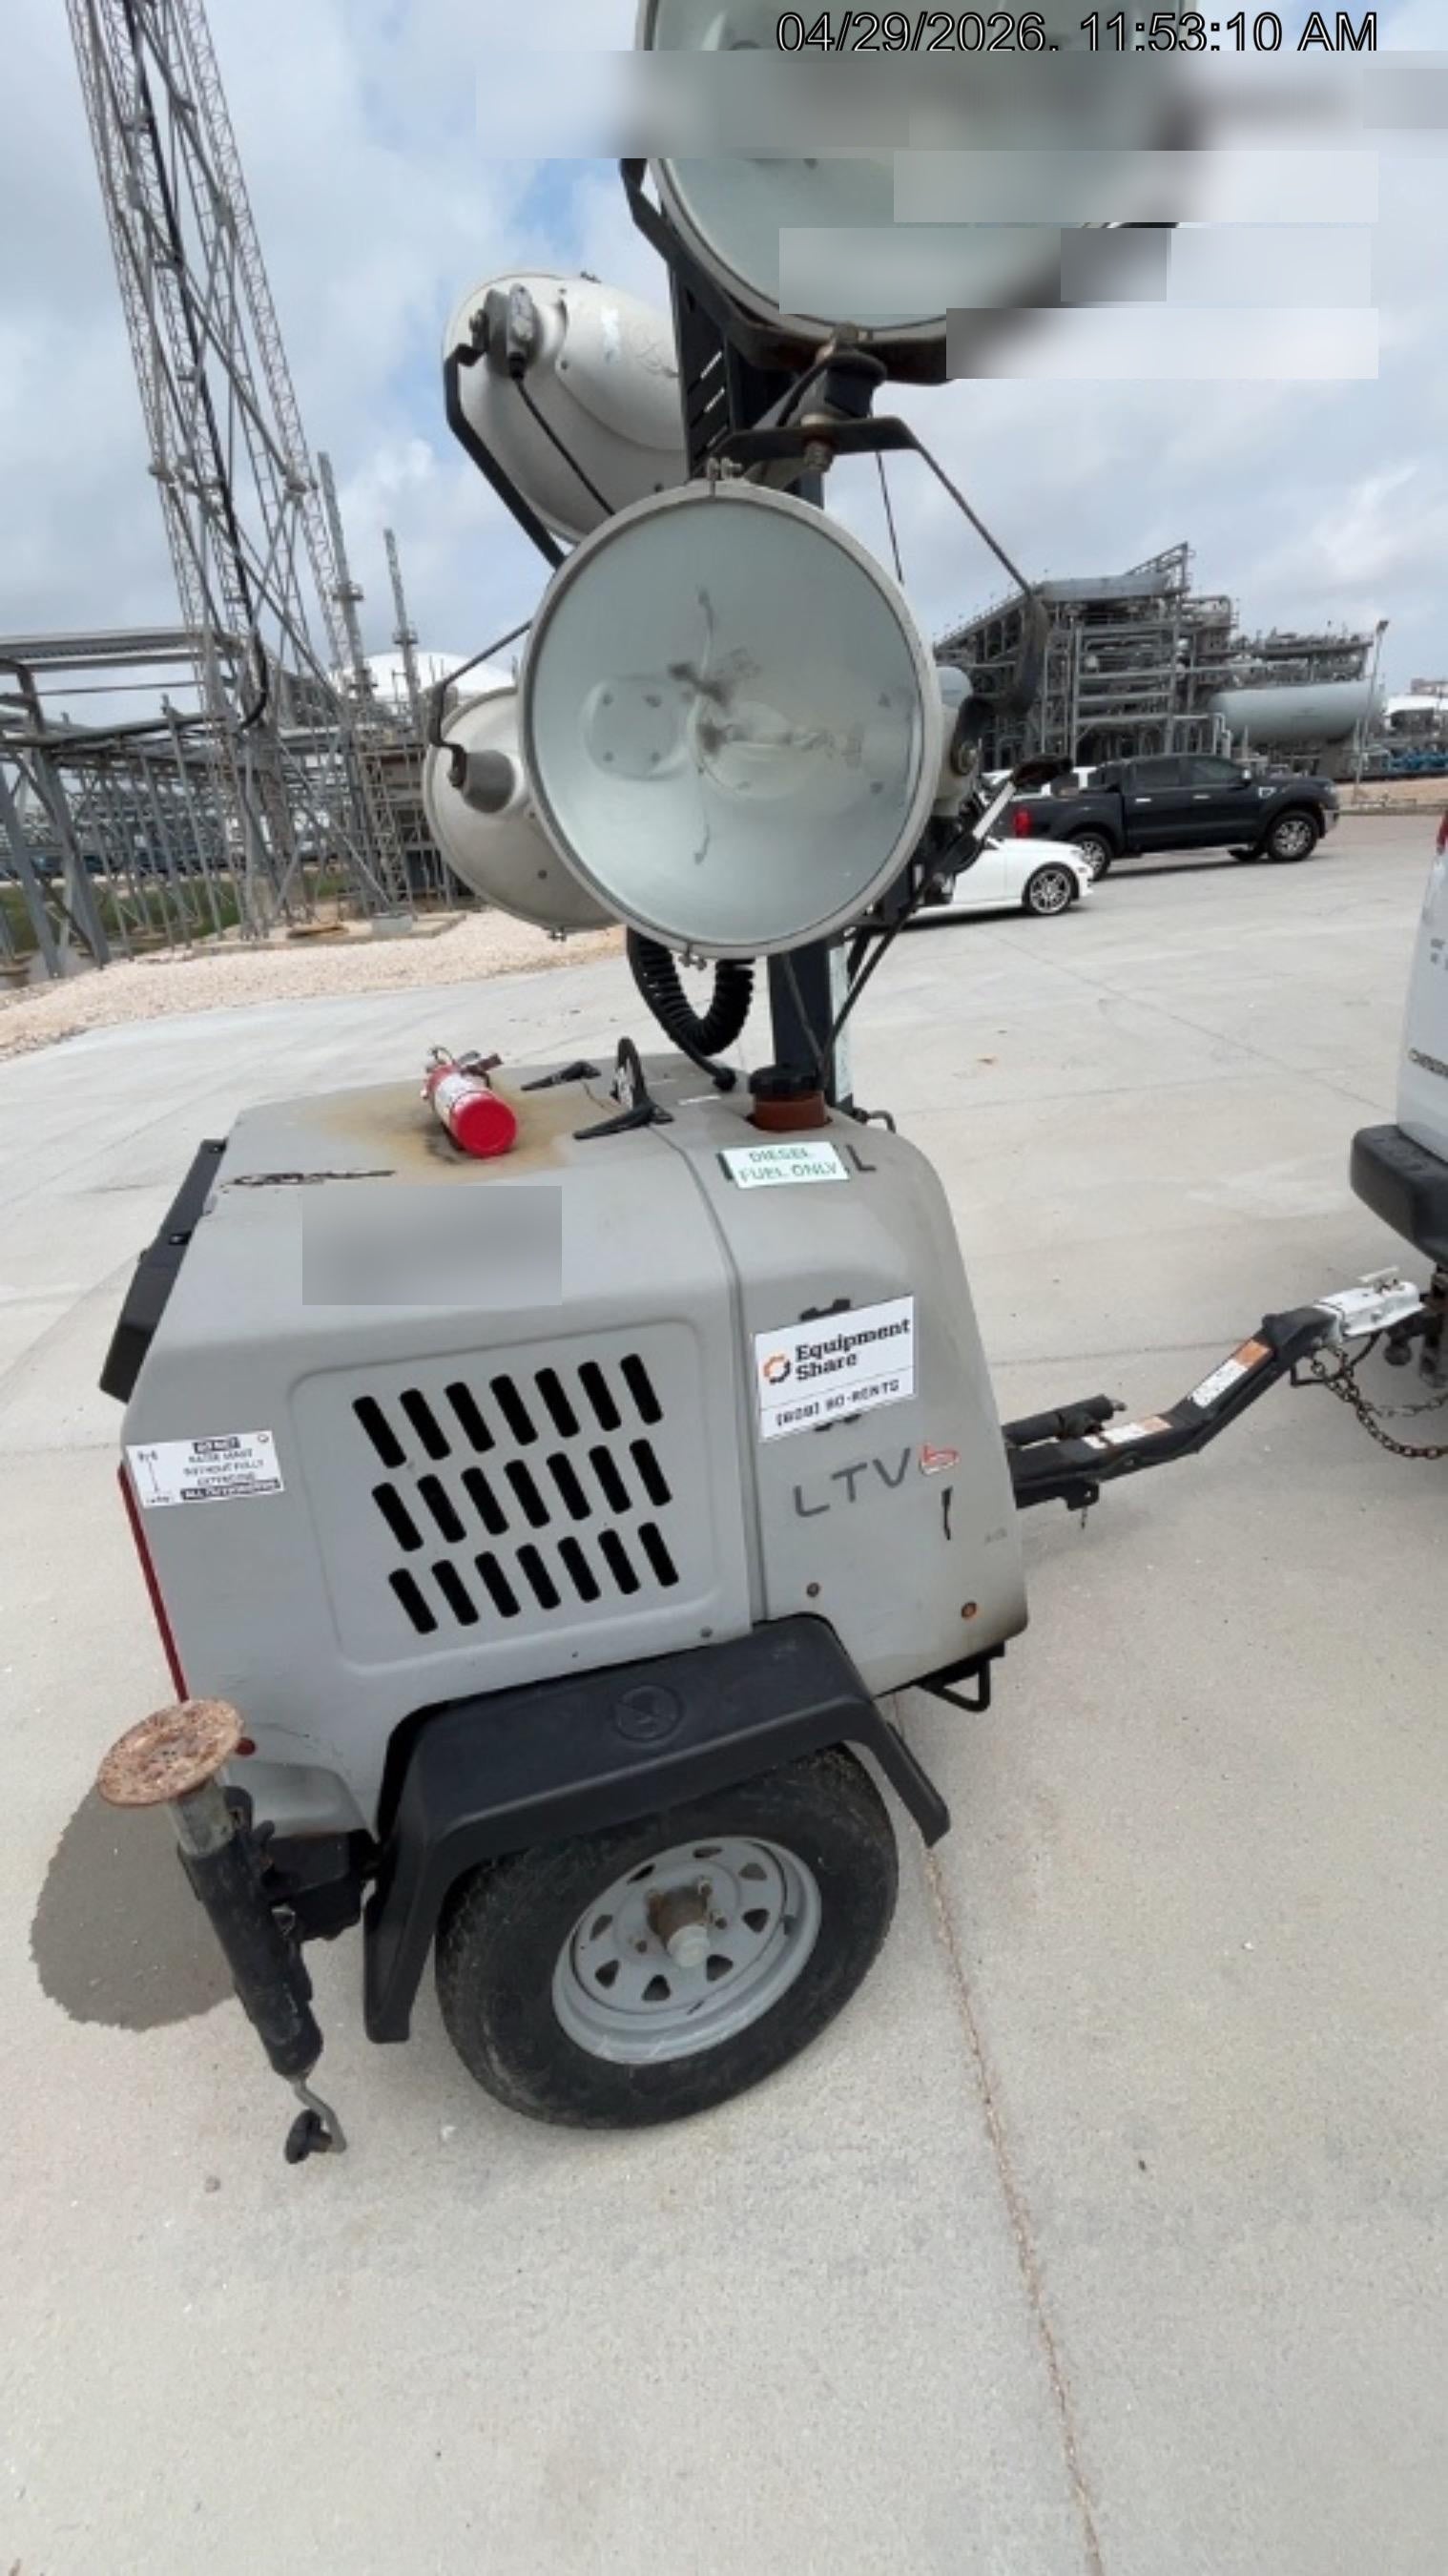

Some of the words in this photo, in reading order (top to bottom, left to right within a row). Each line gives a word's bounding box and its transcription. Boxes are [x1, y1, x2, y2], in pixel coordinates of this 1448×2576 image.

[749, 1147, 812, 1162] DIESEL
[739, 1166, 786, 1182] FUEL
[791, 1161, 837, 1177] ONLY
[795, 1318, 910, 1361] Equipment
[796, 1353, 858, 1381] Share
